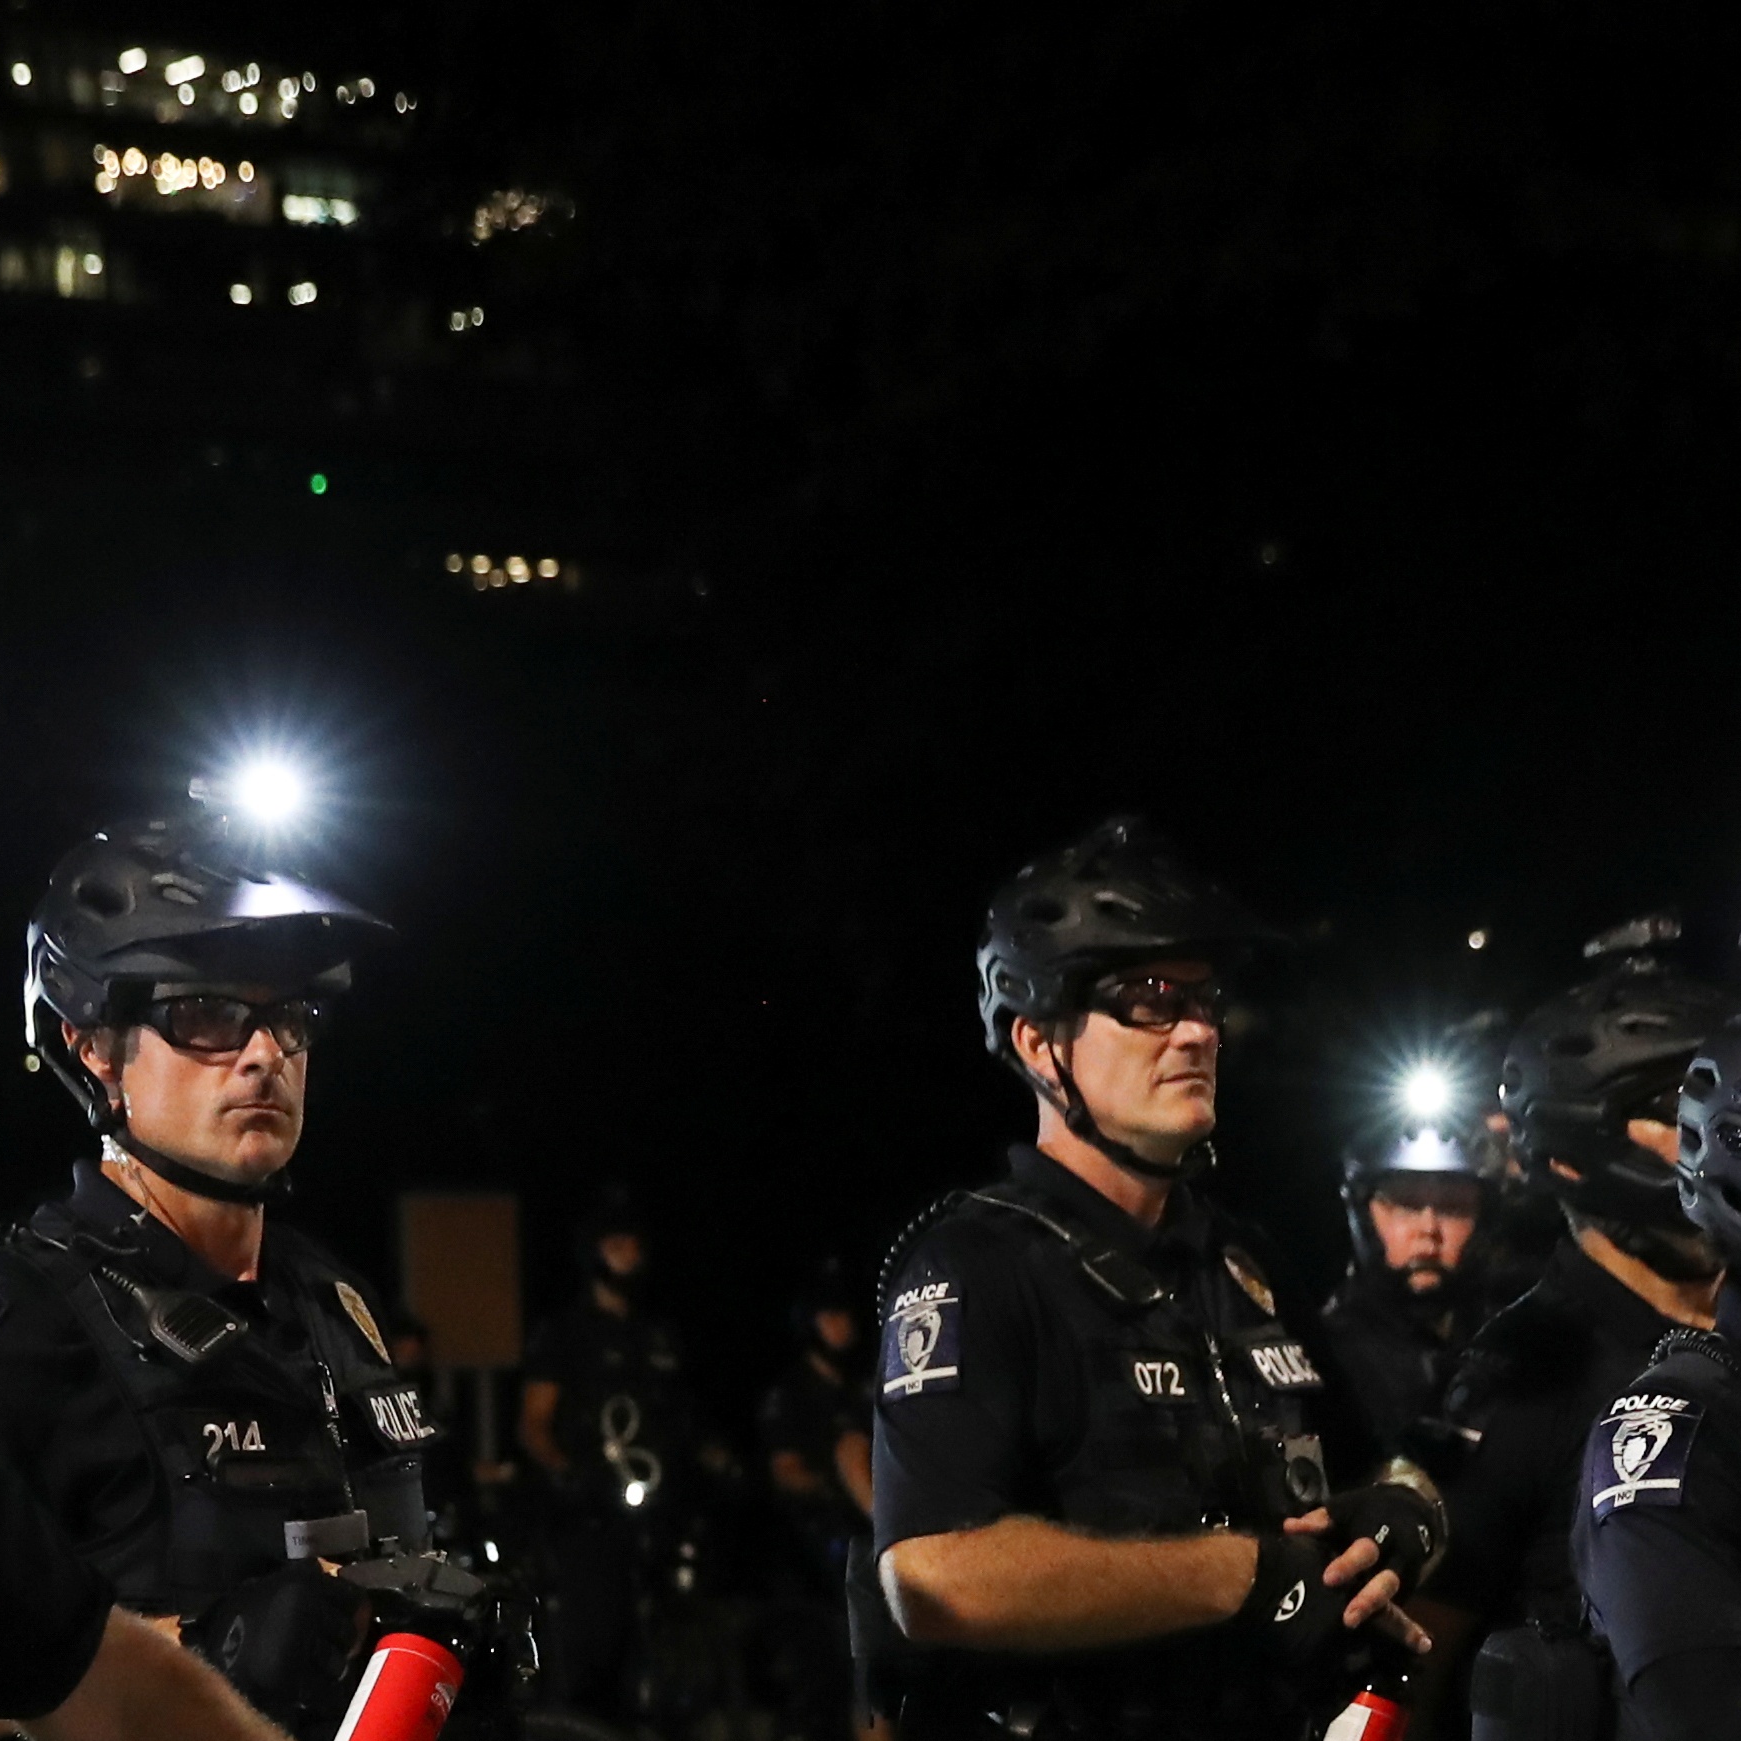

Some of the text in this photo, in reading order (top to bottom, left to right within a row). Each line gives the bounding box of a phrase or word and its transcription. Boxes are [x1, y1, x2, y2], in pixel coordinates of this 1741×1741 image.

[894, 1282, 950, 1312] POLICE
[1134, 1361, 1186, 1396] 072
[369, 1390, 436, 1442] POLICE
[1609, 1394, 1691, 1416] POLICE
[203, 1420, 267, 1460] 214
[1616, 1490, 1633, 1501] NC
